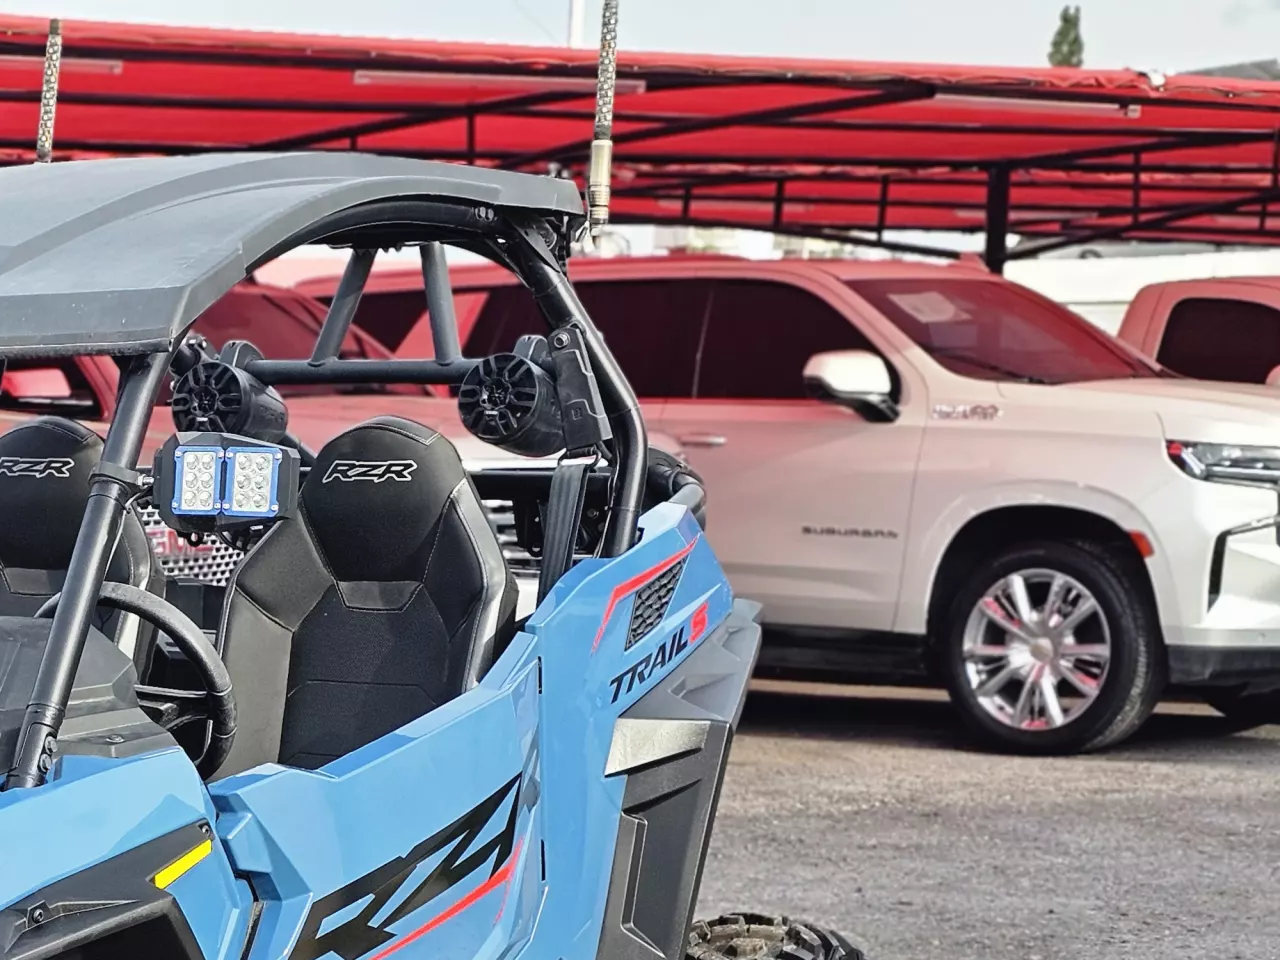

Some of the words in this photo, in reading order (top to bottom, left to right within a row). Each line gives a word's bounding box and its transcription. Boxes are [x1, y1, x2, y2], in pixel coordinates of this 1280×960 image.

[322, 459, 418, 483] RZR
[801, 526, 899, 539] SUBURBAN
[609, 626, 688, 704] TRAIL
[689, 600, 709, 644] S
